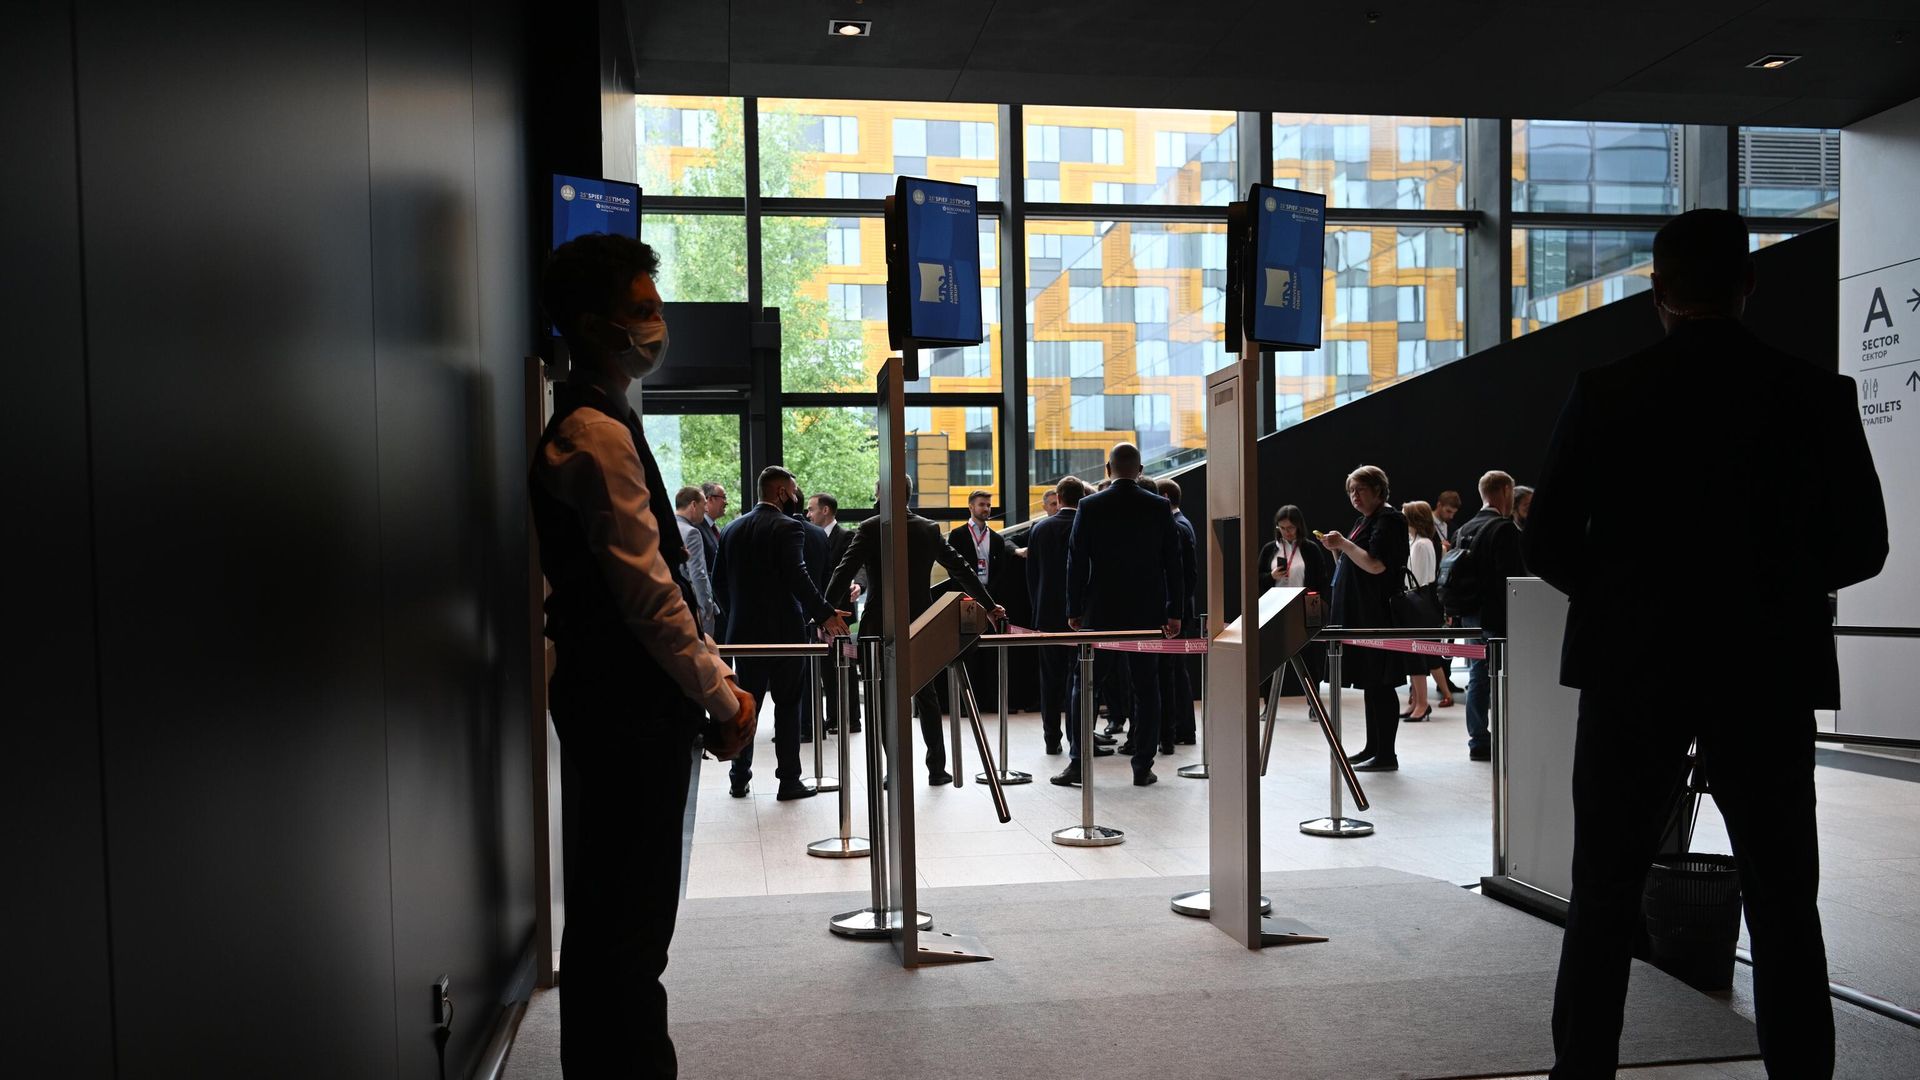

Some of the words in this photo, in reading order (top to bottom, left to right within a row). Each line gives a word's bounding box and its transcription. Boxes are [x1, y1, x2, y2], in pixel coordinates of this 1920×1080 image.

[1863, 286, 1894, 333] A
[1862, 334, 1900, 351] SECTOR
[1862, 350, 1888, 362] СЕКТОР
[1862, 400, 1902, 416] TOILETS
[1862, 415, 1893, 426] ТУАЛЕТЫ
